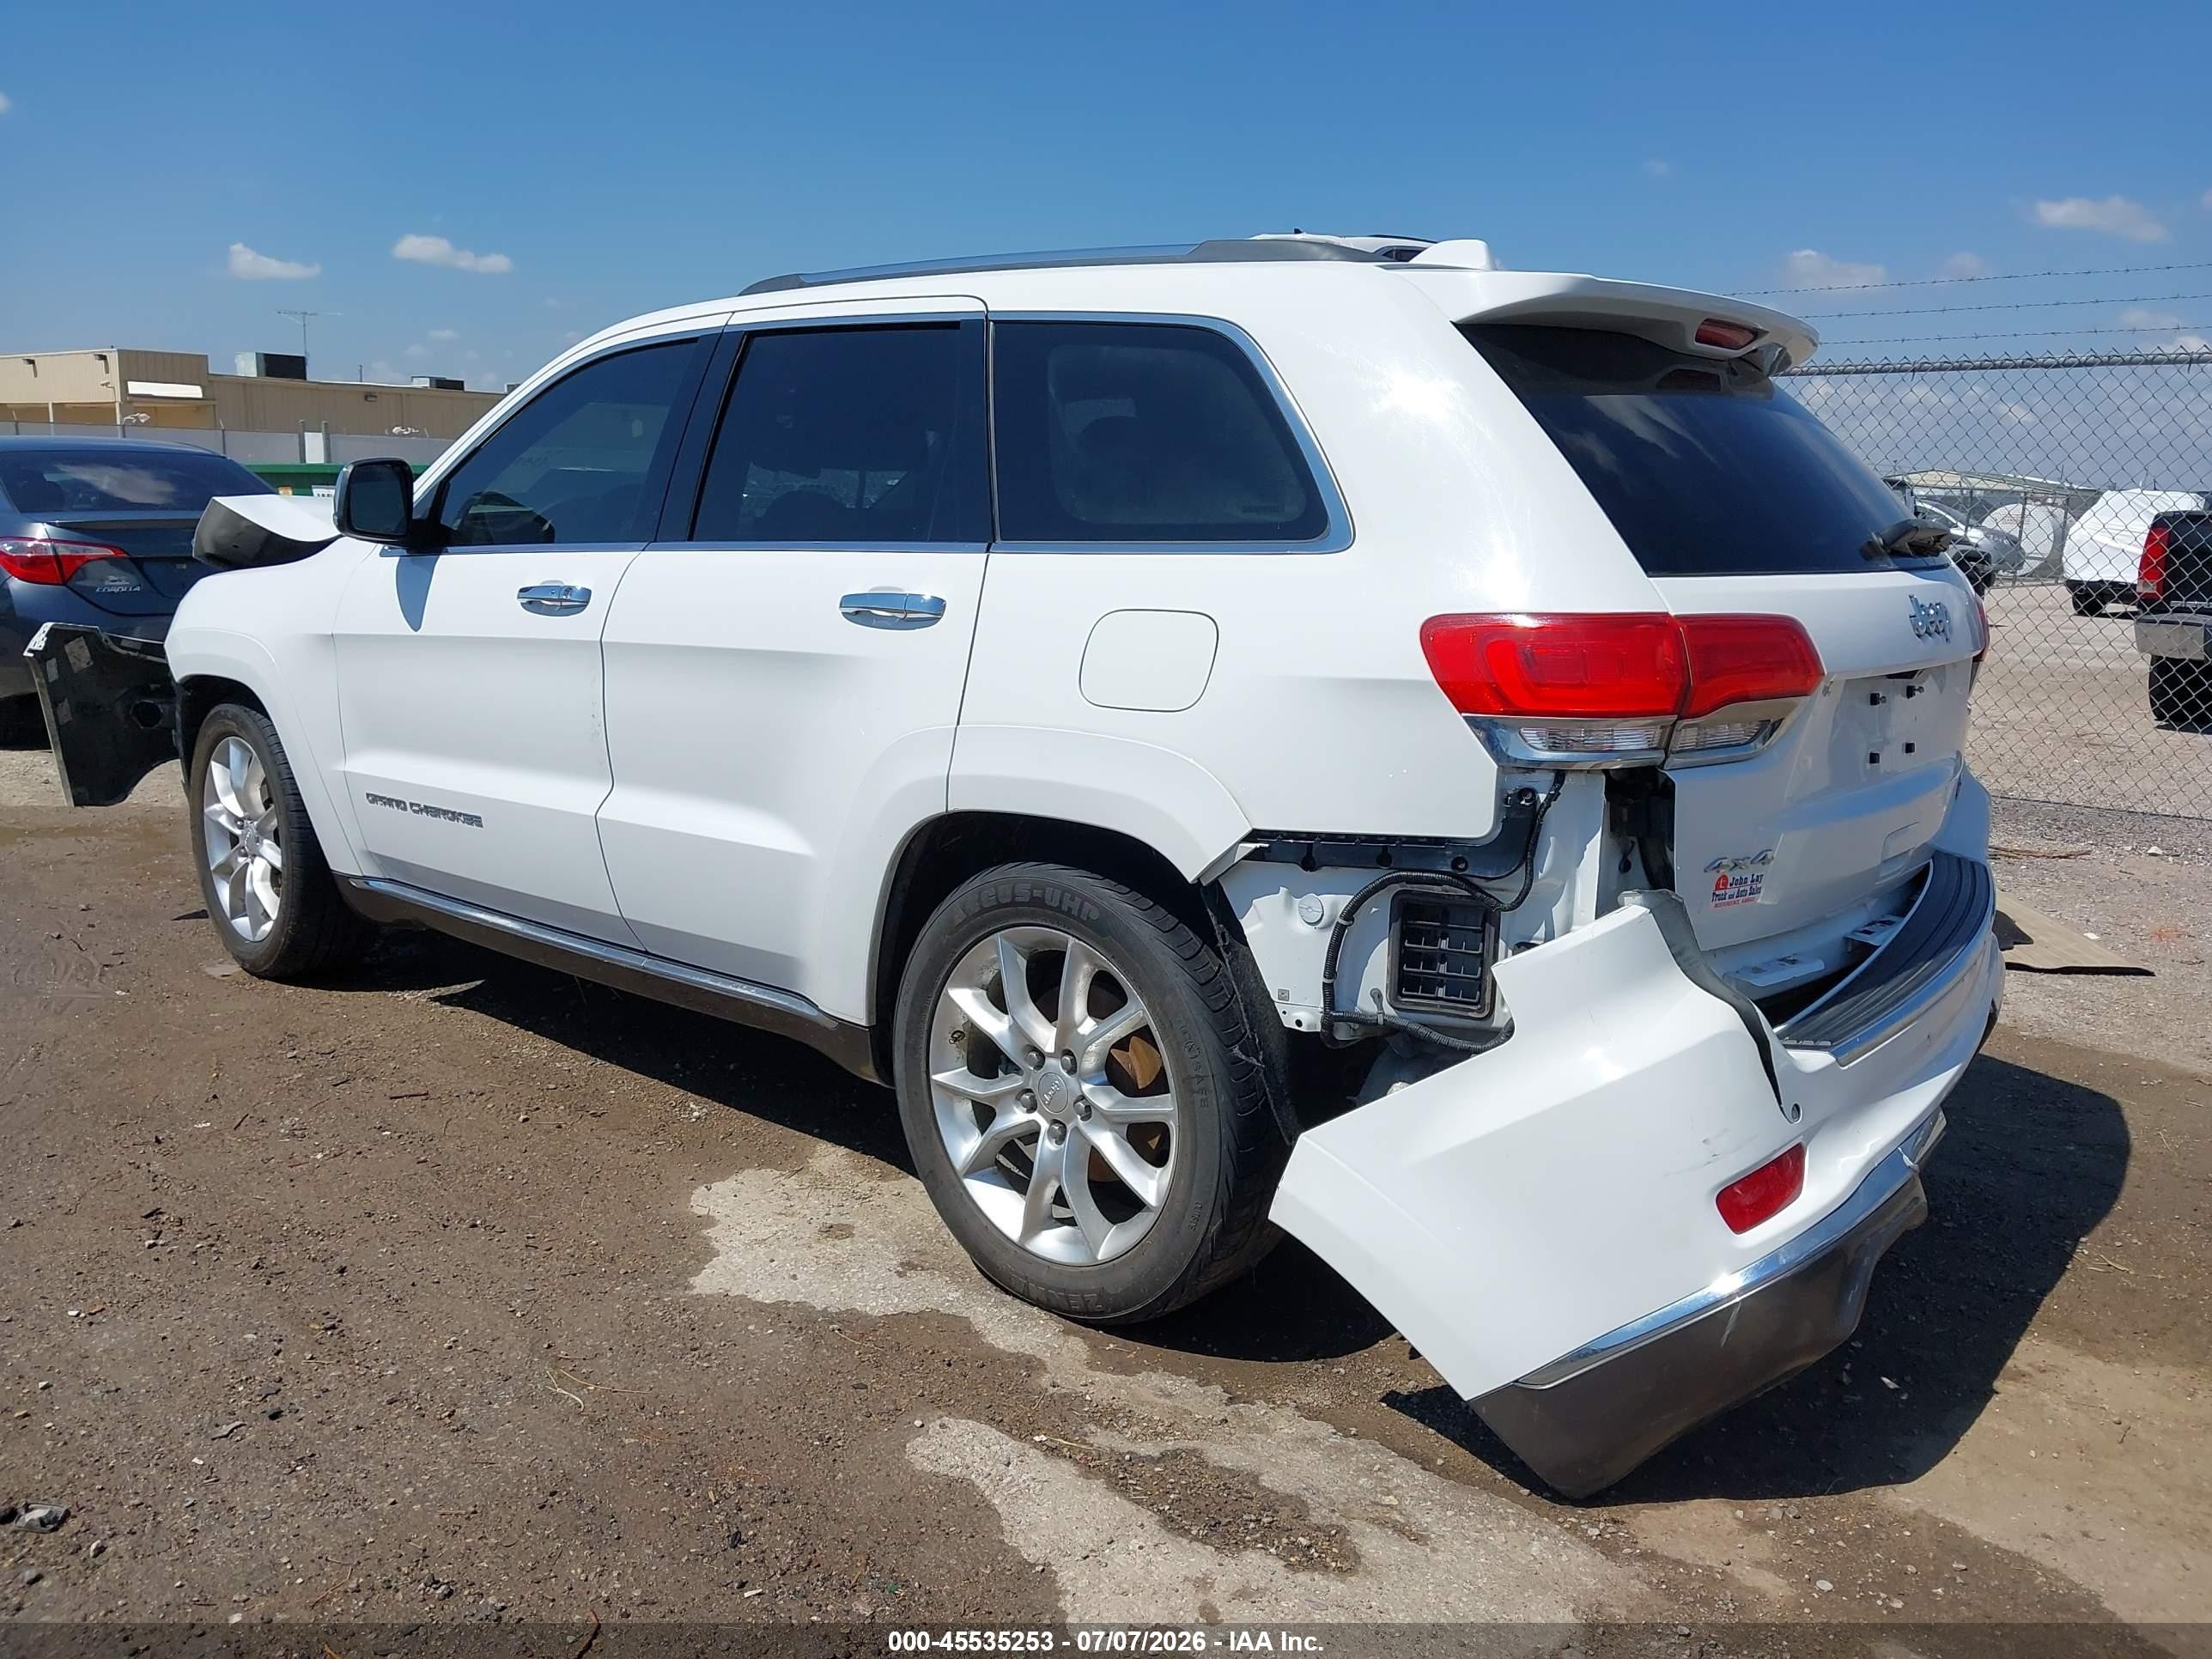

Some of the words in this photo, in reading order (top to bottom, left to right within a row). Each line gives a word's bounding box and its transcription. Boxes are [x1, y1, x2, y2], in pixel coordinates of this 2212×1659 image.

[1908, 594, 1952, 643] Jeep
[365, 792, 408, 812] GRAND
[409, 801, 483, 829] CHEROKEE
[1711, 890, 1728, 902] Truck
[1735, 887, 1749, 899] Auto
[1748, 884, 1762, 896] Sales
[1729, 875, 1749, 887] John
[1750, 872, 1765, 884] Lay
